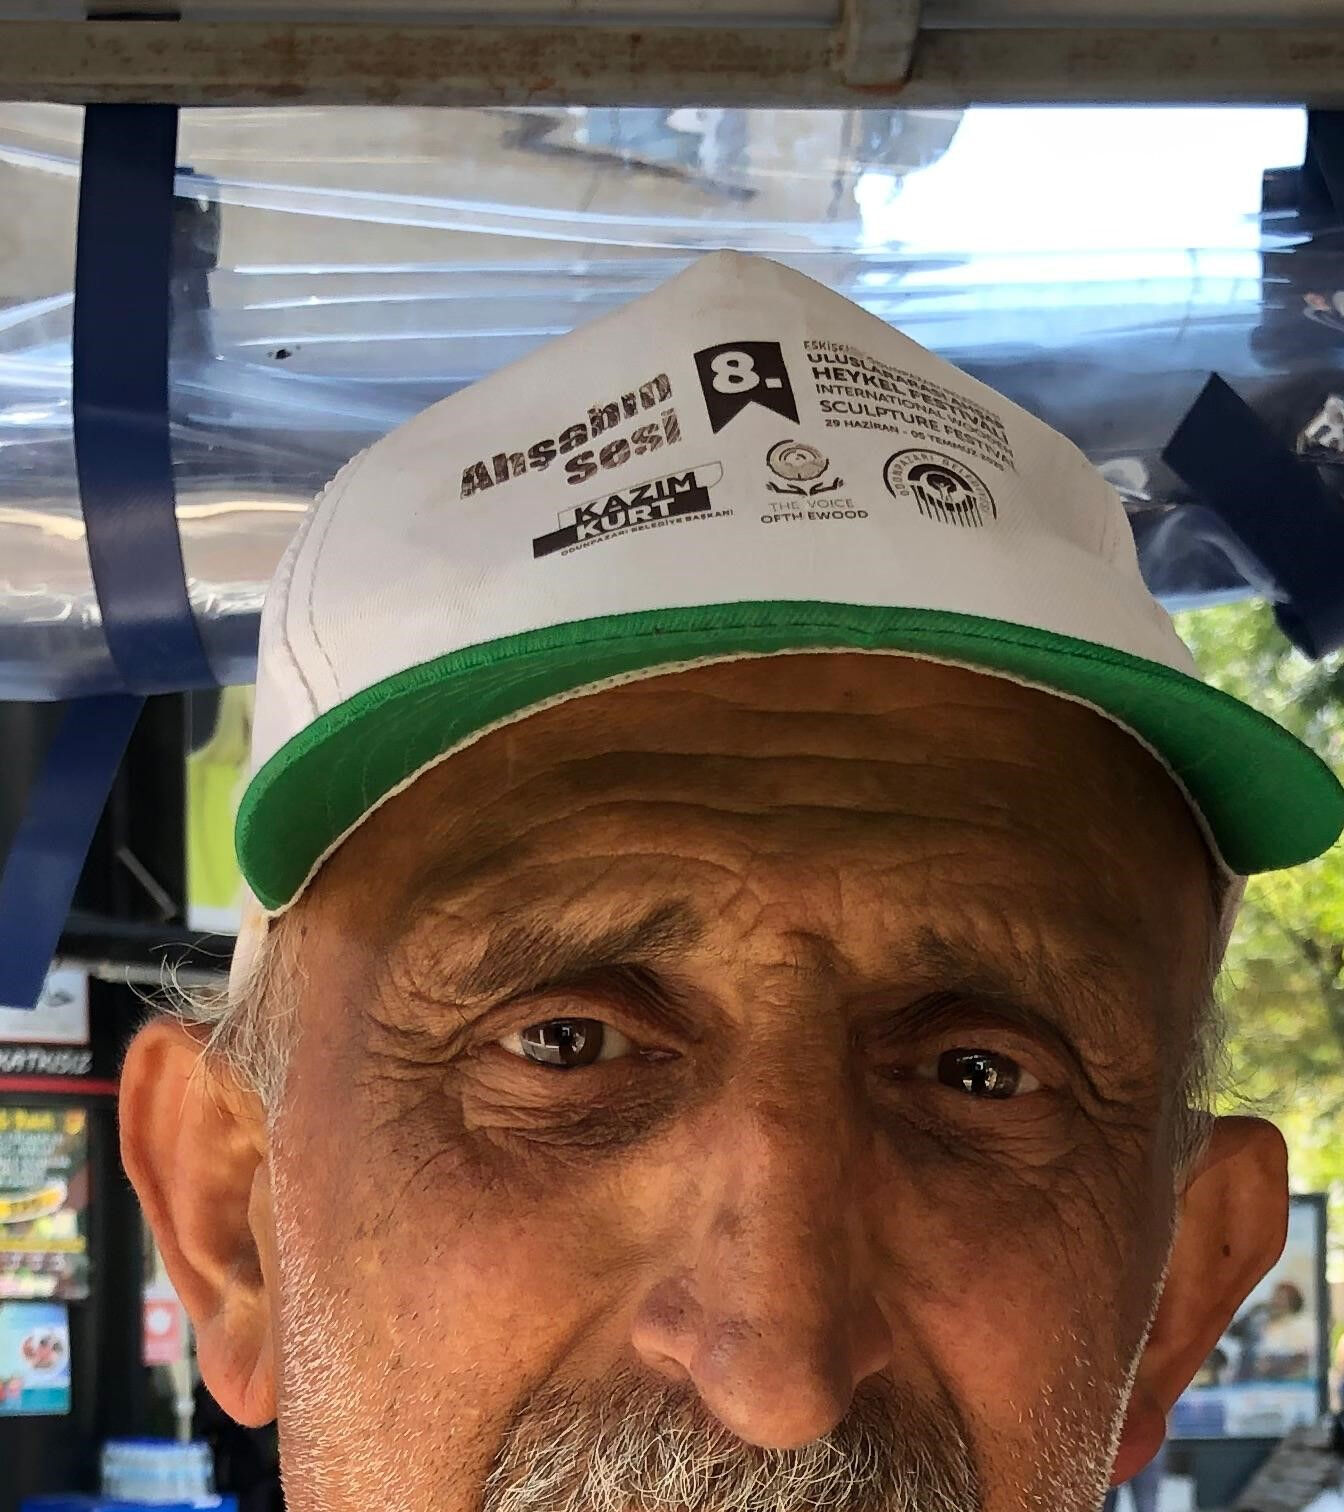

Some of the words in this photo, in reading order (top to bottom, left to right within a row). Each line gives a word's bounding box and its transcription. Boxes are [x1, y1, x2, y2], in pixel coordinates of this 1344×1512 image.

[710, 351, 783, 394] 8.
[811, 366, 907, 396] HEYKEL
[815, 383, 945, 420] INTERNATIONAL
[819, 399, 942, 433] SCULPTURE
[843, 419, 900, 435] HAZİRAN
[573, 471, 697, 524] KAZIM
[767, 502, 801, 512] THE
[807, 498, 855, 509] VOICE
[576, 497, 675, 542] KURT
